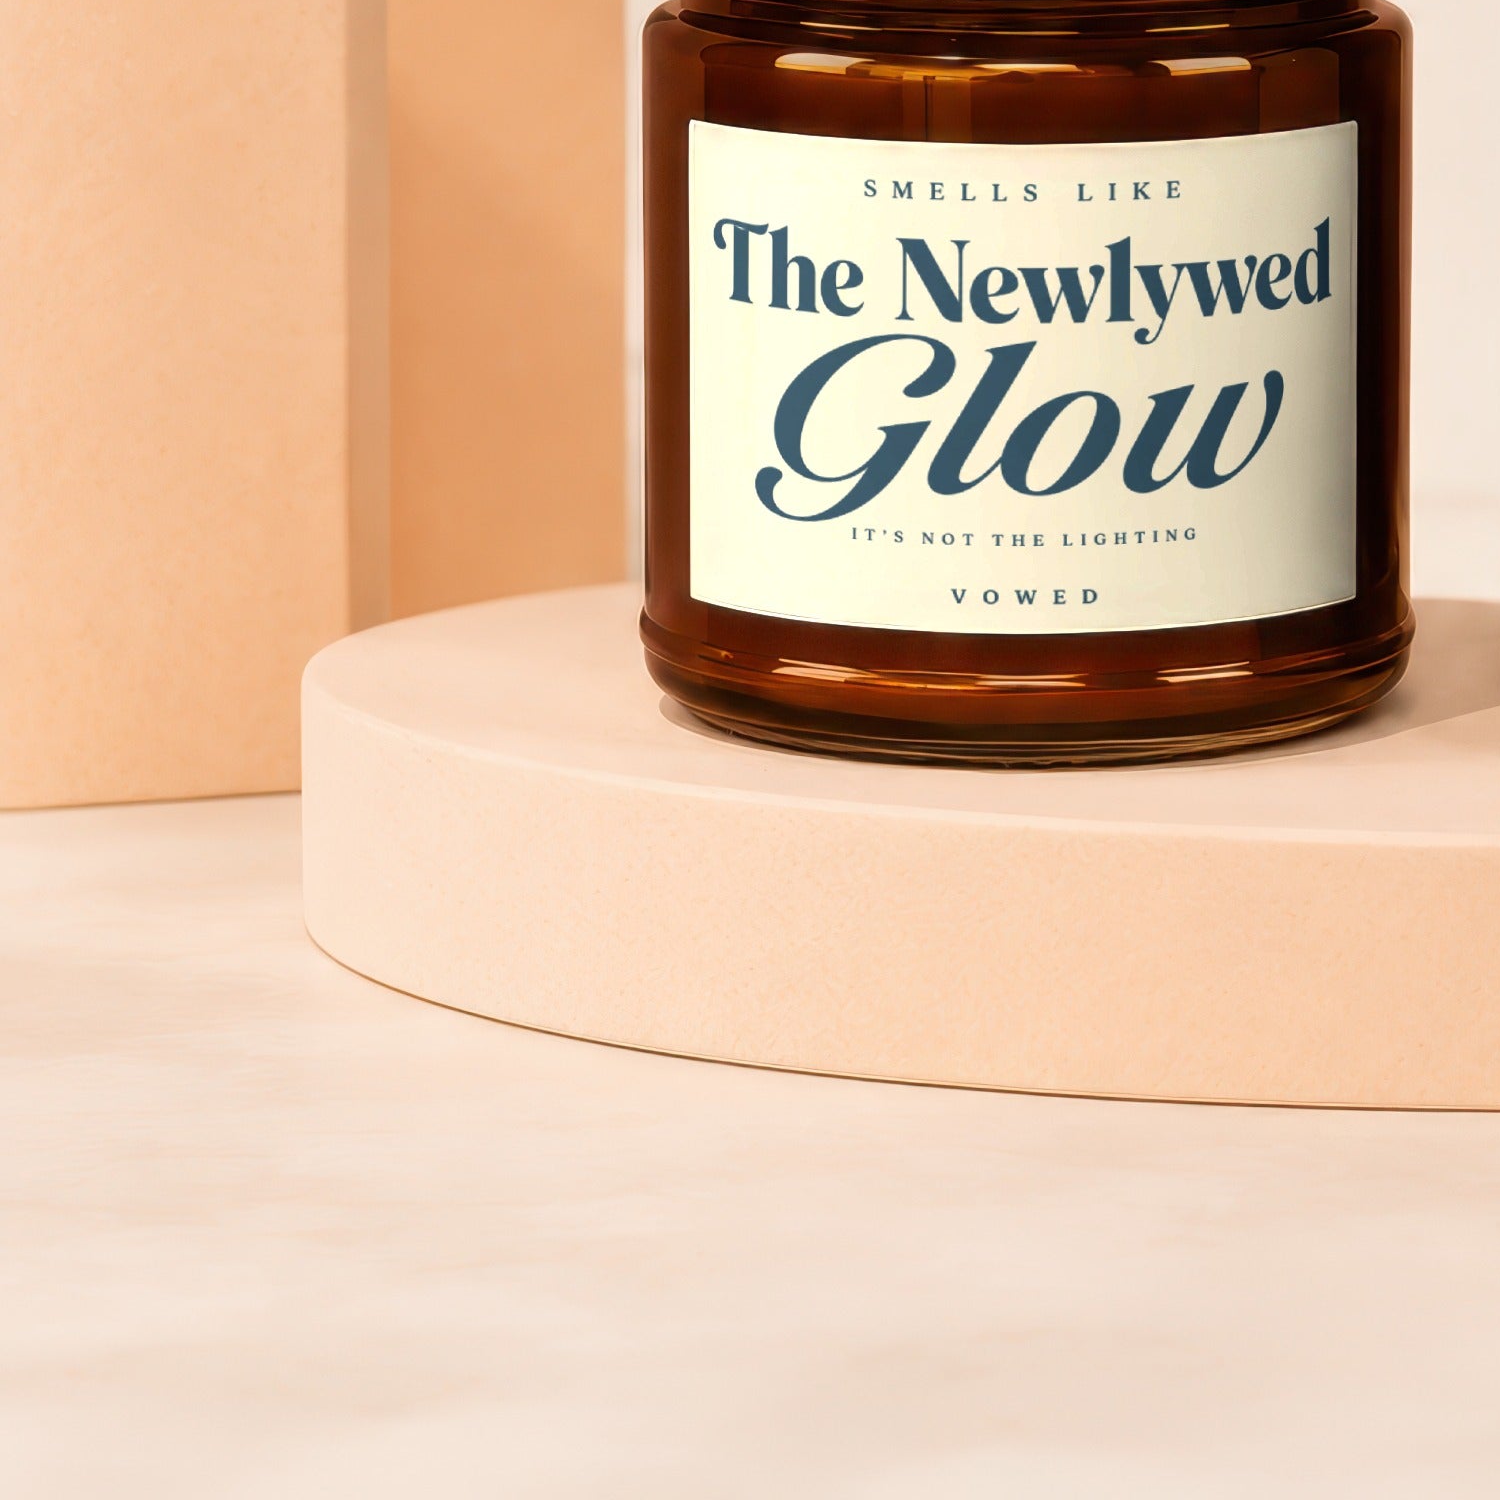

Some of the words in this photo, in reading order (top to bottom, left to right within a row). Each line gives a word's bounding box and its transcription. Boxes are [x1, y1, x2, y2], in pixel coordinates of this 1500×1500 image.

[863, 178, 1039, 202] SMELLS
[1077, 180, 1183, 202] LIKE
[712, 217, 865, 318] The
[895, 217, 1333, 345] Newlywed
[754, 333, 1285, 522] Glow
[850, 526, 905, 545] IT'S
[921, 531, 976, 547] NOT
[991, 533, 1045, 548] THE
[1062, 527, 1199, 548] LIGHTING
[950, 588, 1100, 606] VOWED
